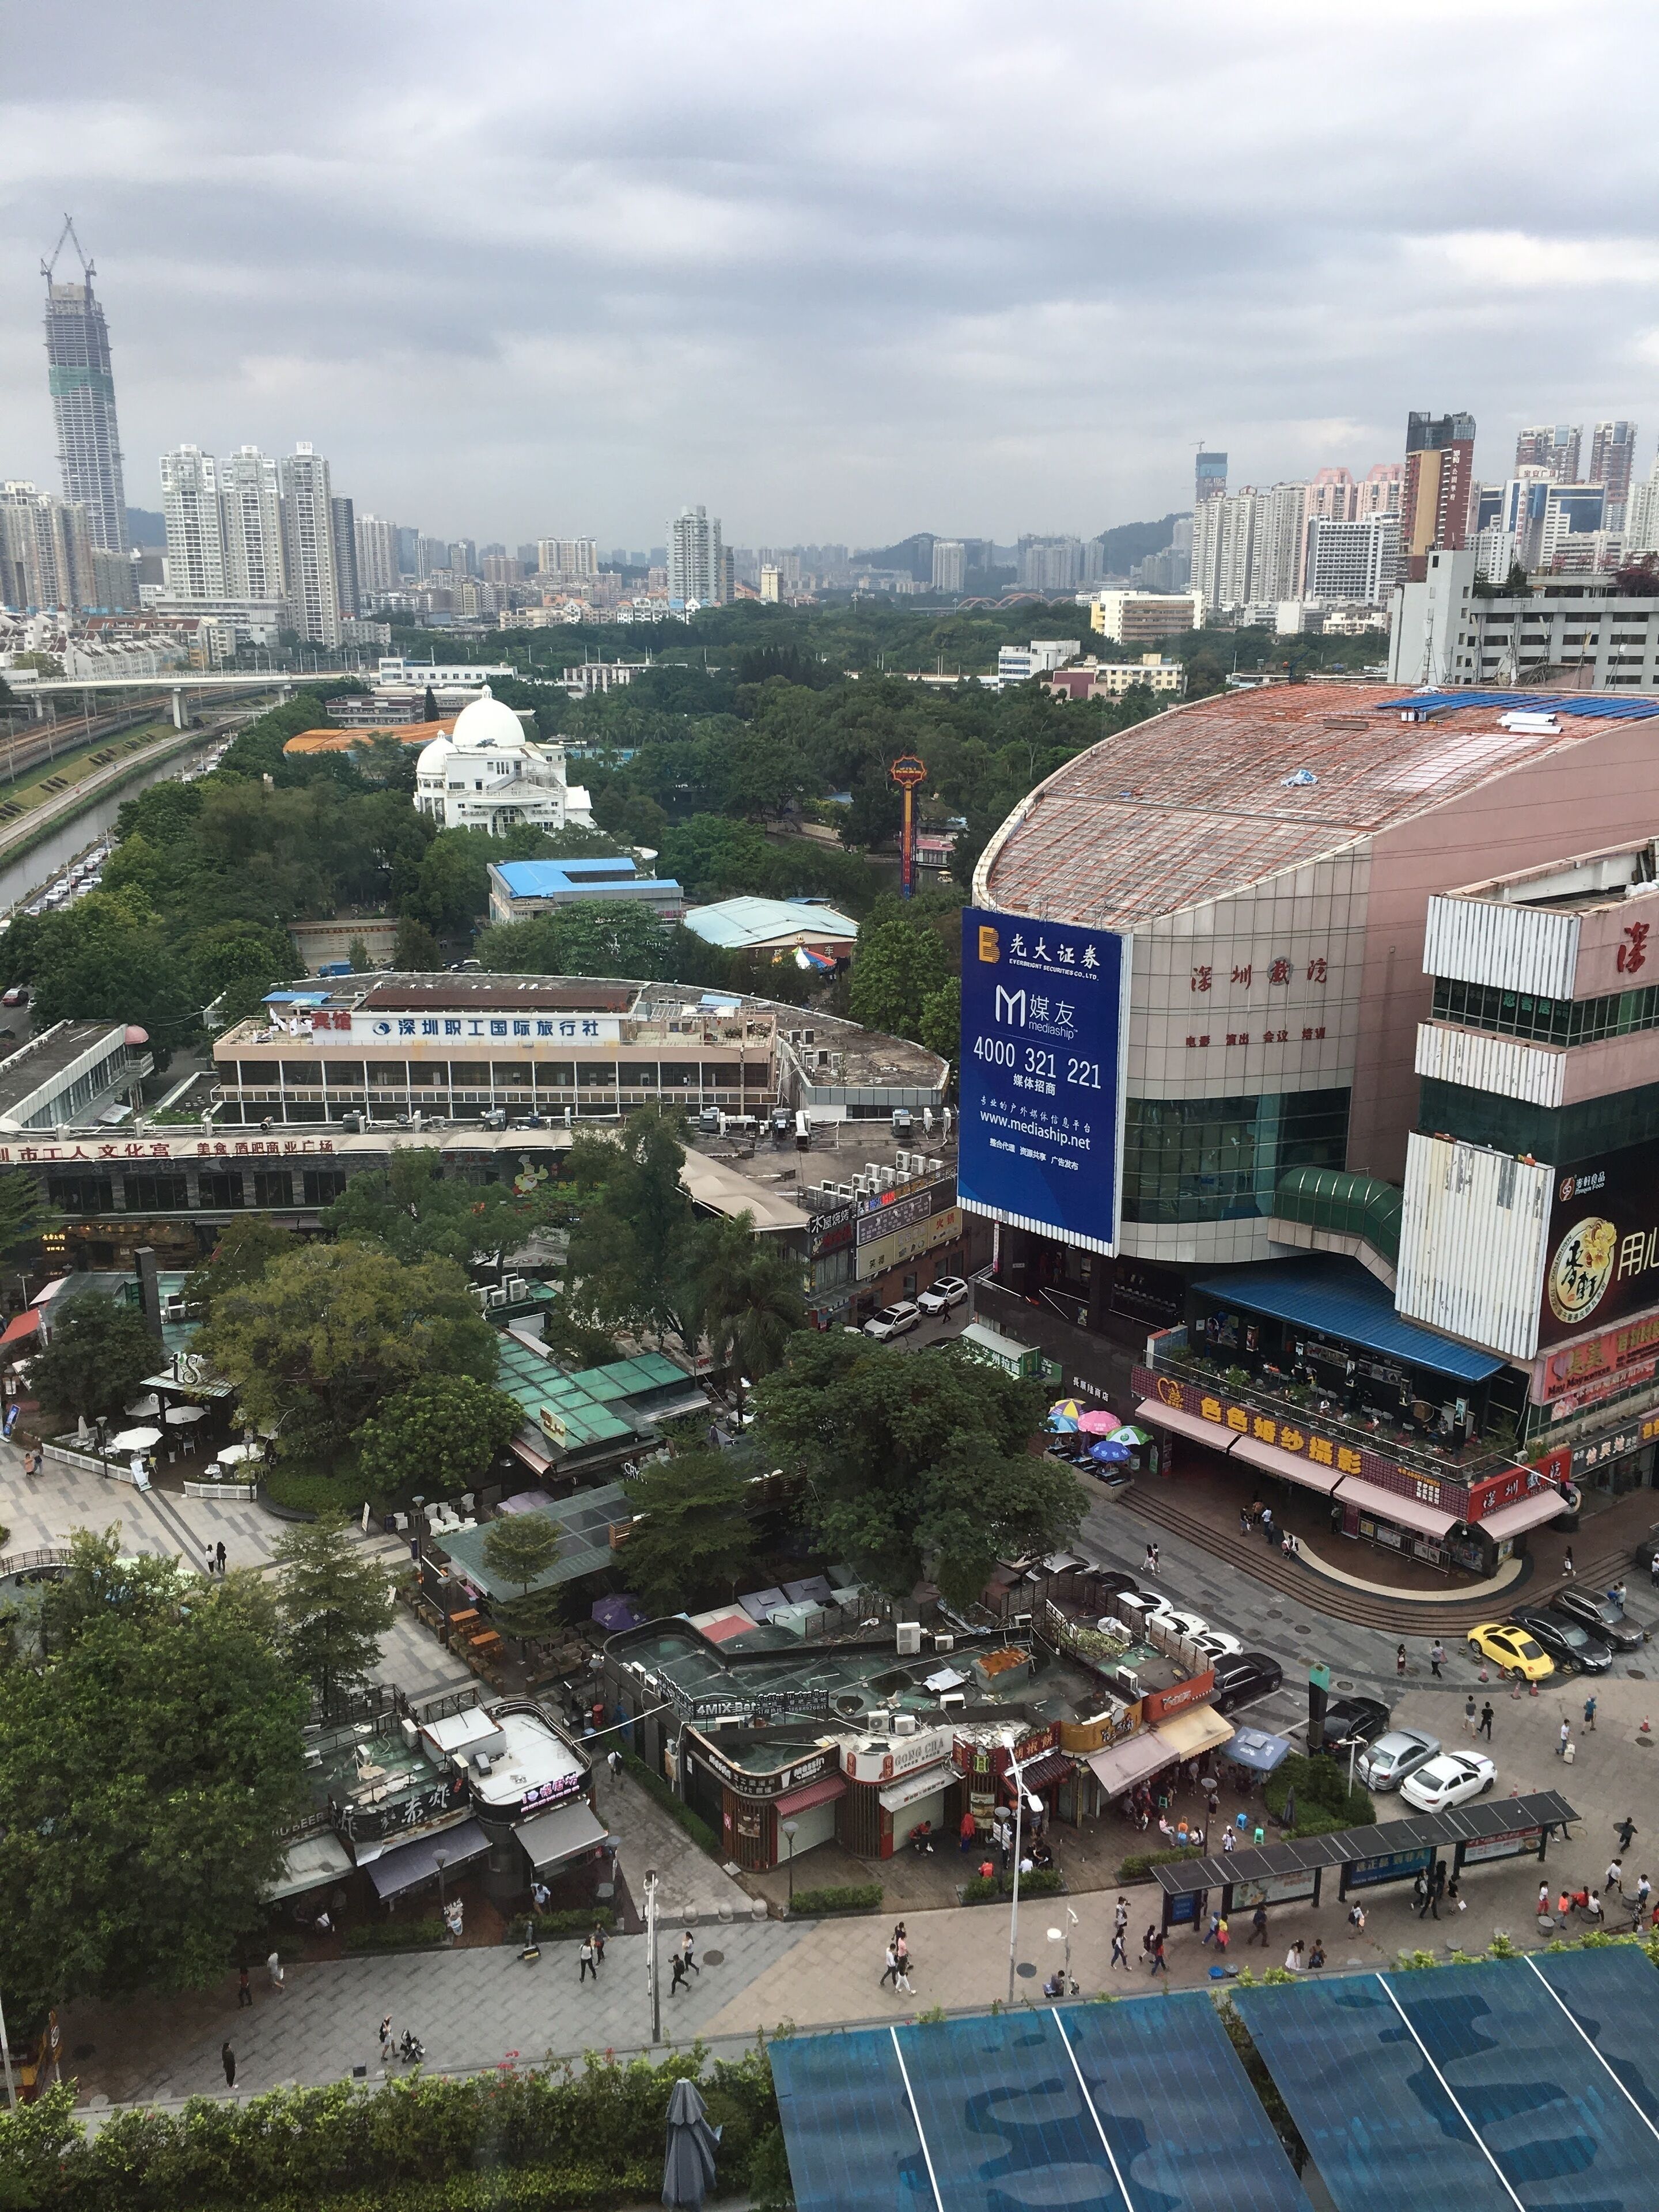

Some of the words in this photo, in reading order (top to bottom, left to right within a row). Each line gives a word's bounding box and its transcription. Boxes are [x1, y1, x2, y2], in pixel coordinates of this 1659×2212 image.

[1009, 933, 1100, 969] 光大证券
[1009, 959, 1042, 969] EVERBRIGHT
[1043, 965, 1074, 976] SECURITIES
[311, 1012, 352, 1031] 宾馆
[1029, 993, 1075, 1028] 媒友
[398, 1018, 599, 1037] 深圳职工国际旅行社
[1029, 1021, 1075, 1041] mediaship
[973, 1036, 1015, 1067] 4000
[1024, 1047, 1056, 1078] 321
[1067, 1058, 1101, 1089] 221
[1013, 1073, 1056, 1096] 媒体招商
[980, 1095, 1091, 1134] 专业的户外媒体信息平台
[980, 1110, 1091, 1150] www.mediaship.net
[1051, 1156, 1079, 1171] 广告发布
[811, 1209, 849, 1233] 木屋烧烤
[1200, 1396, 1362, 1475] 色色婚纱摄影
[697, 1702, 732, 1716] 4MIX
